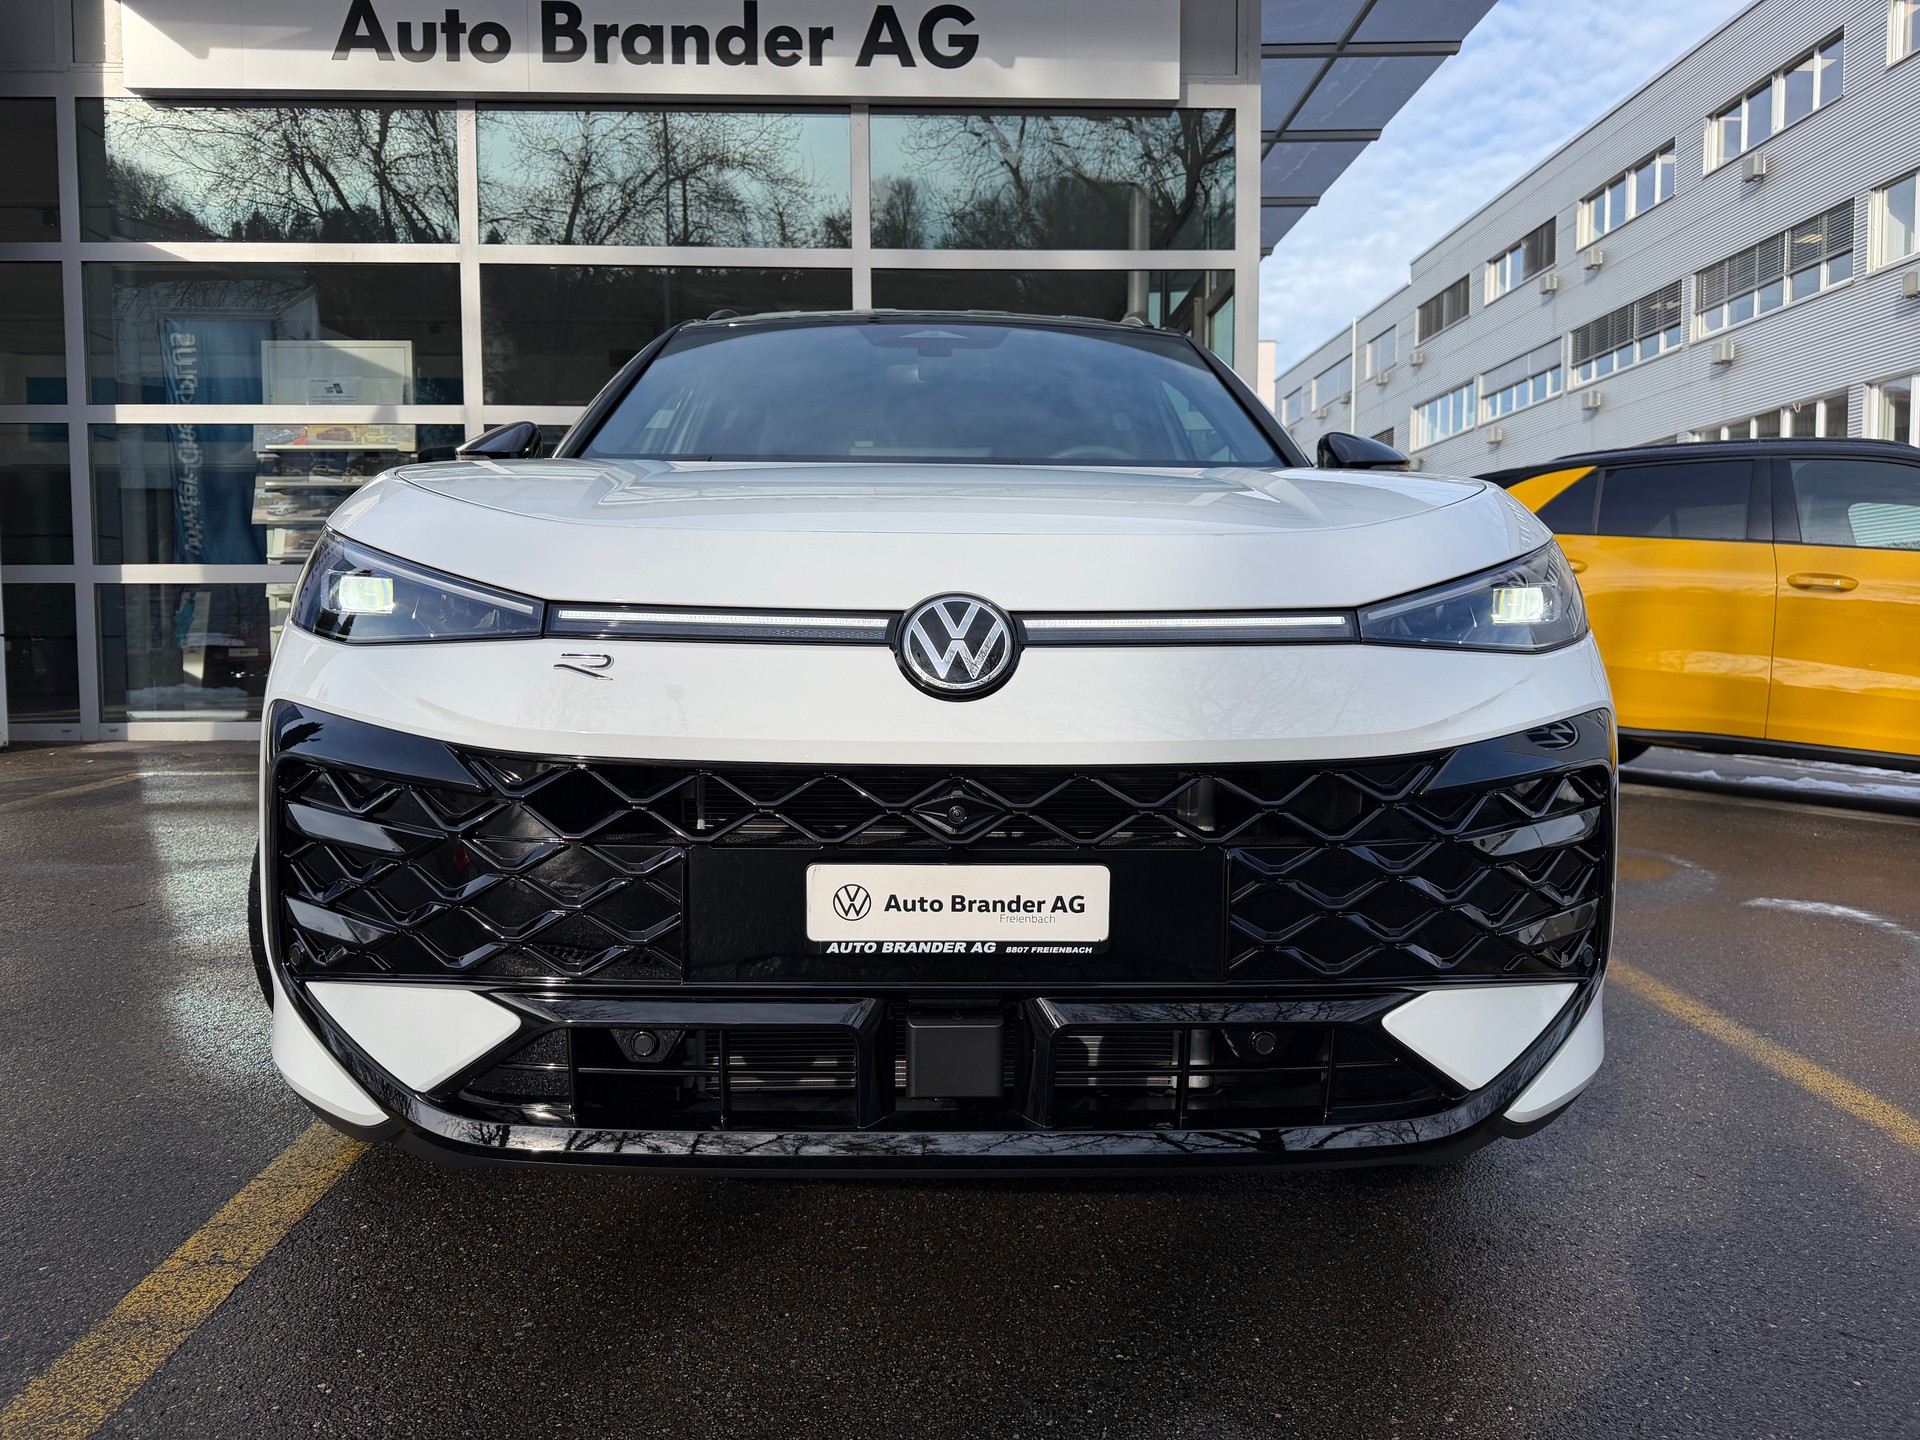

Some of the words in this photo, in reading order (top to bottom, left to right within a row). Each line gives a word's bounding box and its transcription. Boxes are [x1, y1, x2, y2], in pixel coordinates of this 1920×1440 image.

[332, 0, 511, 62] Auto
[541, 0, 834, 67] Brander
[856, 4, 980, 70] AG
[884, 894, 944, 913] Auto
[951, 894, 1046, 914] Brander
[1051, 895, 1085, 914] AG
[1000, 913, 1056, 924] Freienbach
[826, 942, 877, 954] AUTO
[882, 942, 967, 954] BRANDER
[970, 942, 997, 954] AG
[1006, 946, 1029, 954] 8807
[1031, 946, 1093, 954] FREIENBACH
